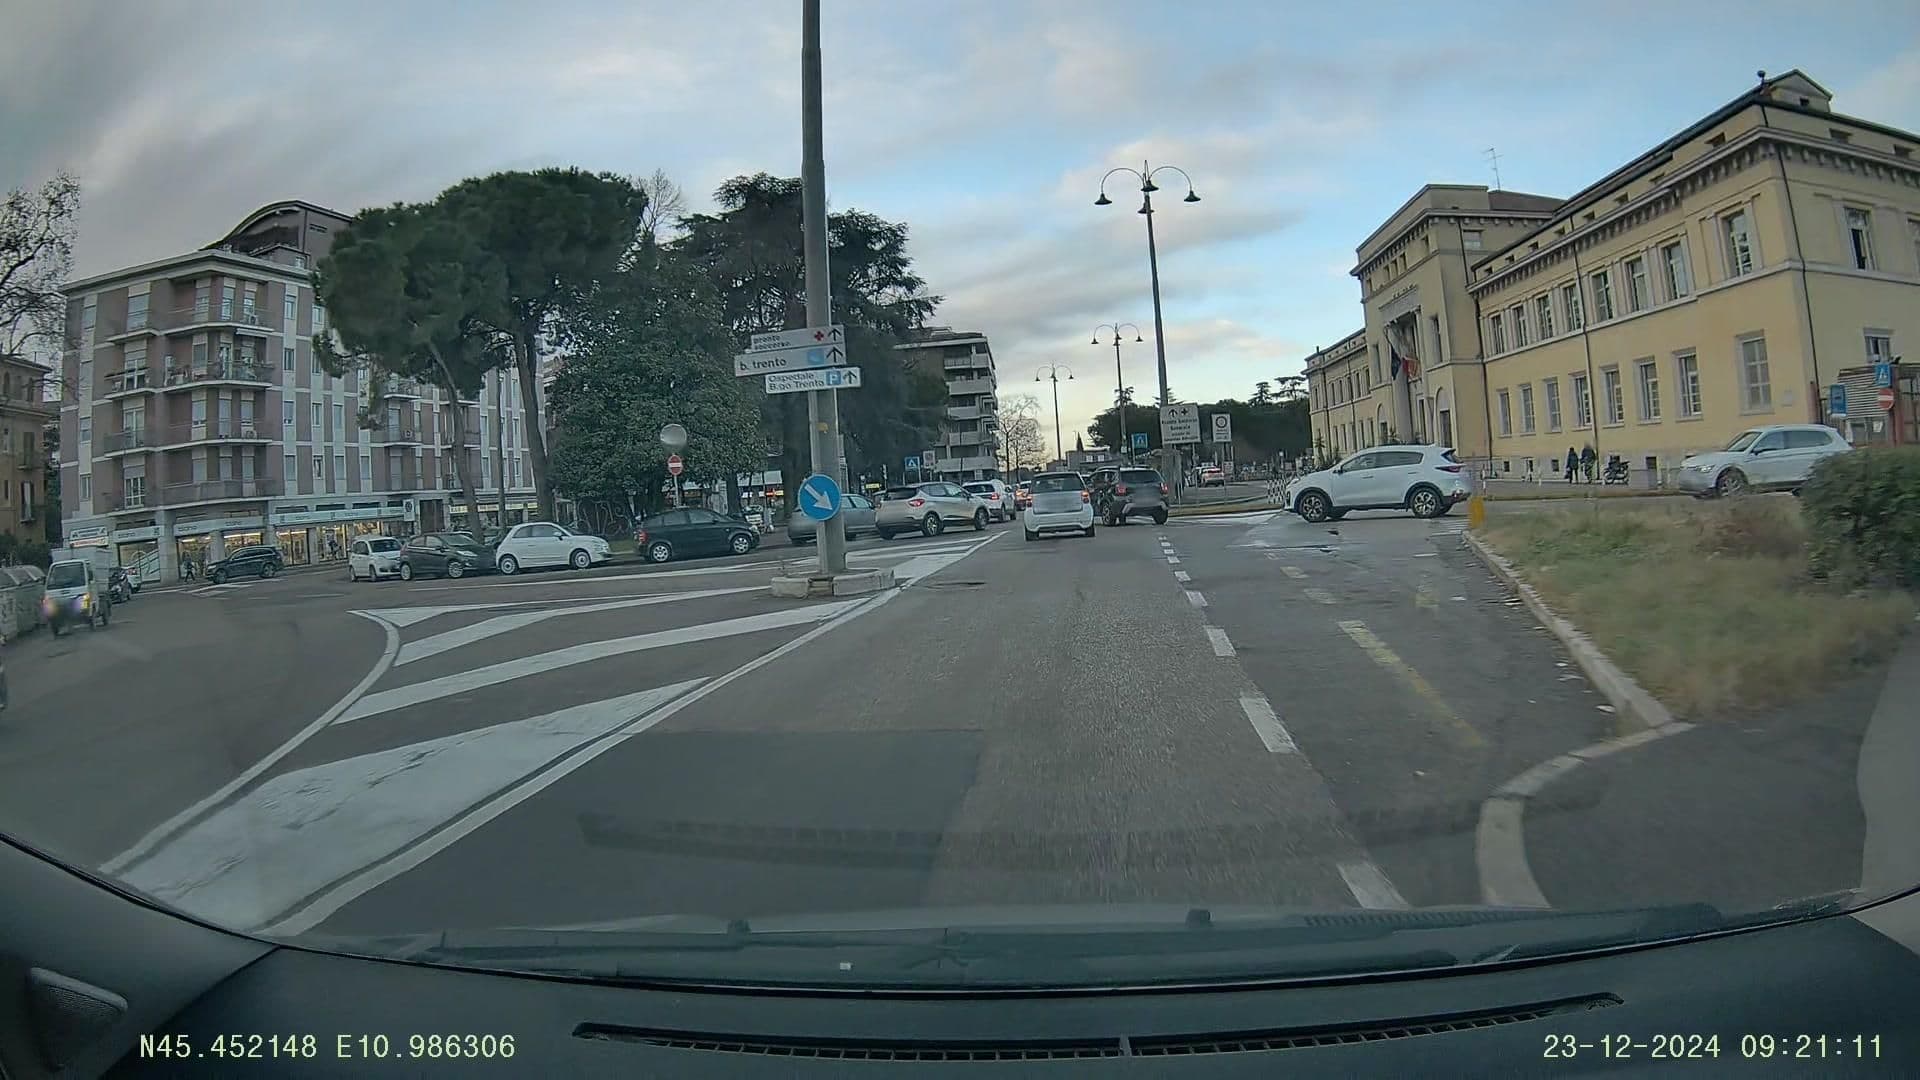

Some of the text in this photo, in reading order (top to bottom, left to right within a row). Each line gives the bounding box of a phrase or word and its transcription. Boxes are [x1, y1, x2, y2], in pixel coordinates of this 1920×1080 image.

[740, 358, 787, 371] b. trento
[768, 373, 815, 382] Ospedale
[794, 379, 825, 389] Trento
